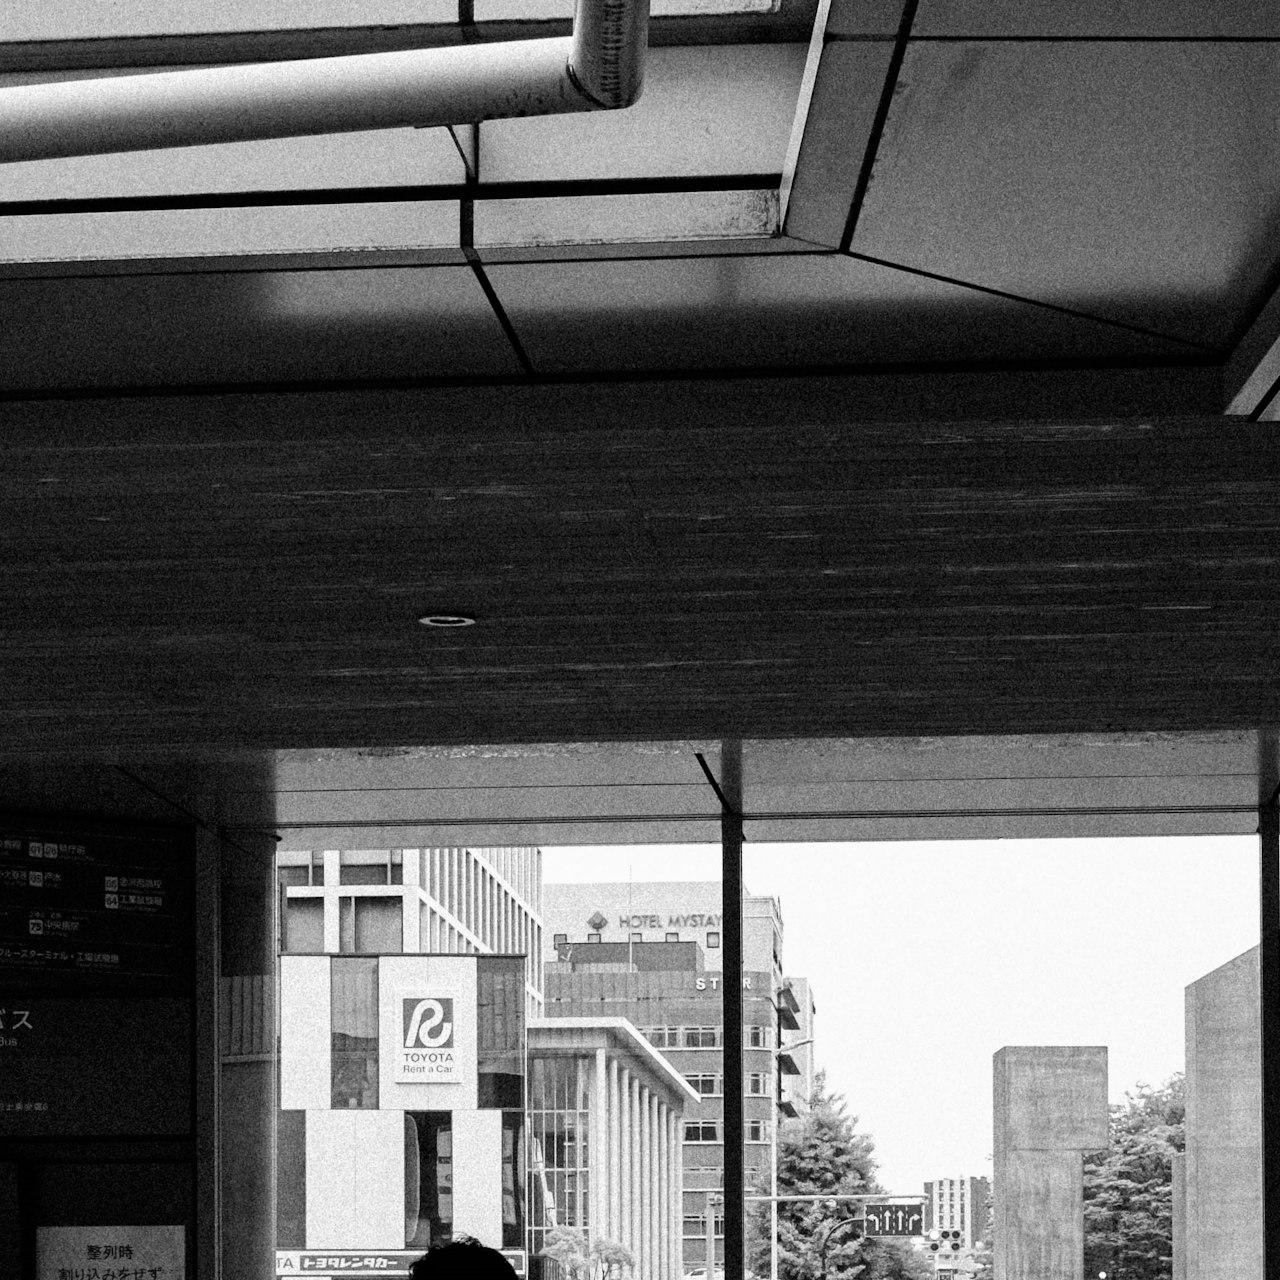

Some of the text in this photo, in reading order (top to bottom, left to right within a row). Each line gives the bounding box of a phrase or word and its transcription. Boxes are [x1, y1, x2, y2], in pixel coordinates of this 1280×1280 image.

[619, 914, 663, 929] HOTEL
[695, 976, 752, 991] STR
[403, 1053, 453, 1063] TOYOTA
[403, 1065, 426, 1074] Rent
[436, 1065, 453, 1074] Car
[87, 1244, 133, 1260] 整列時
[304, 1257, 398, 1268] トヨタレンタカー
